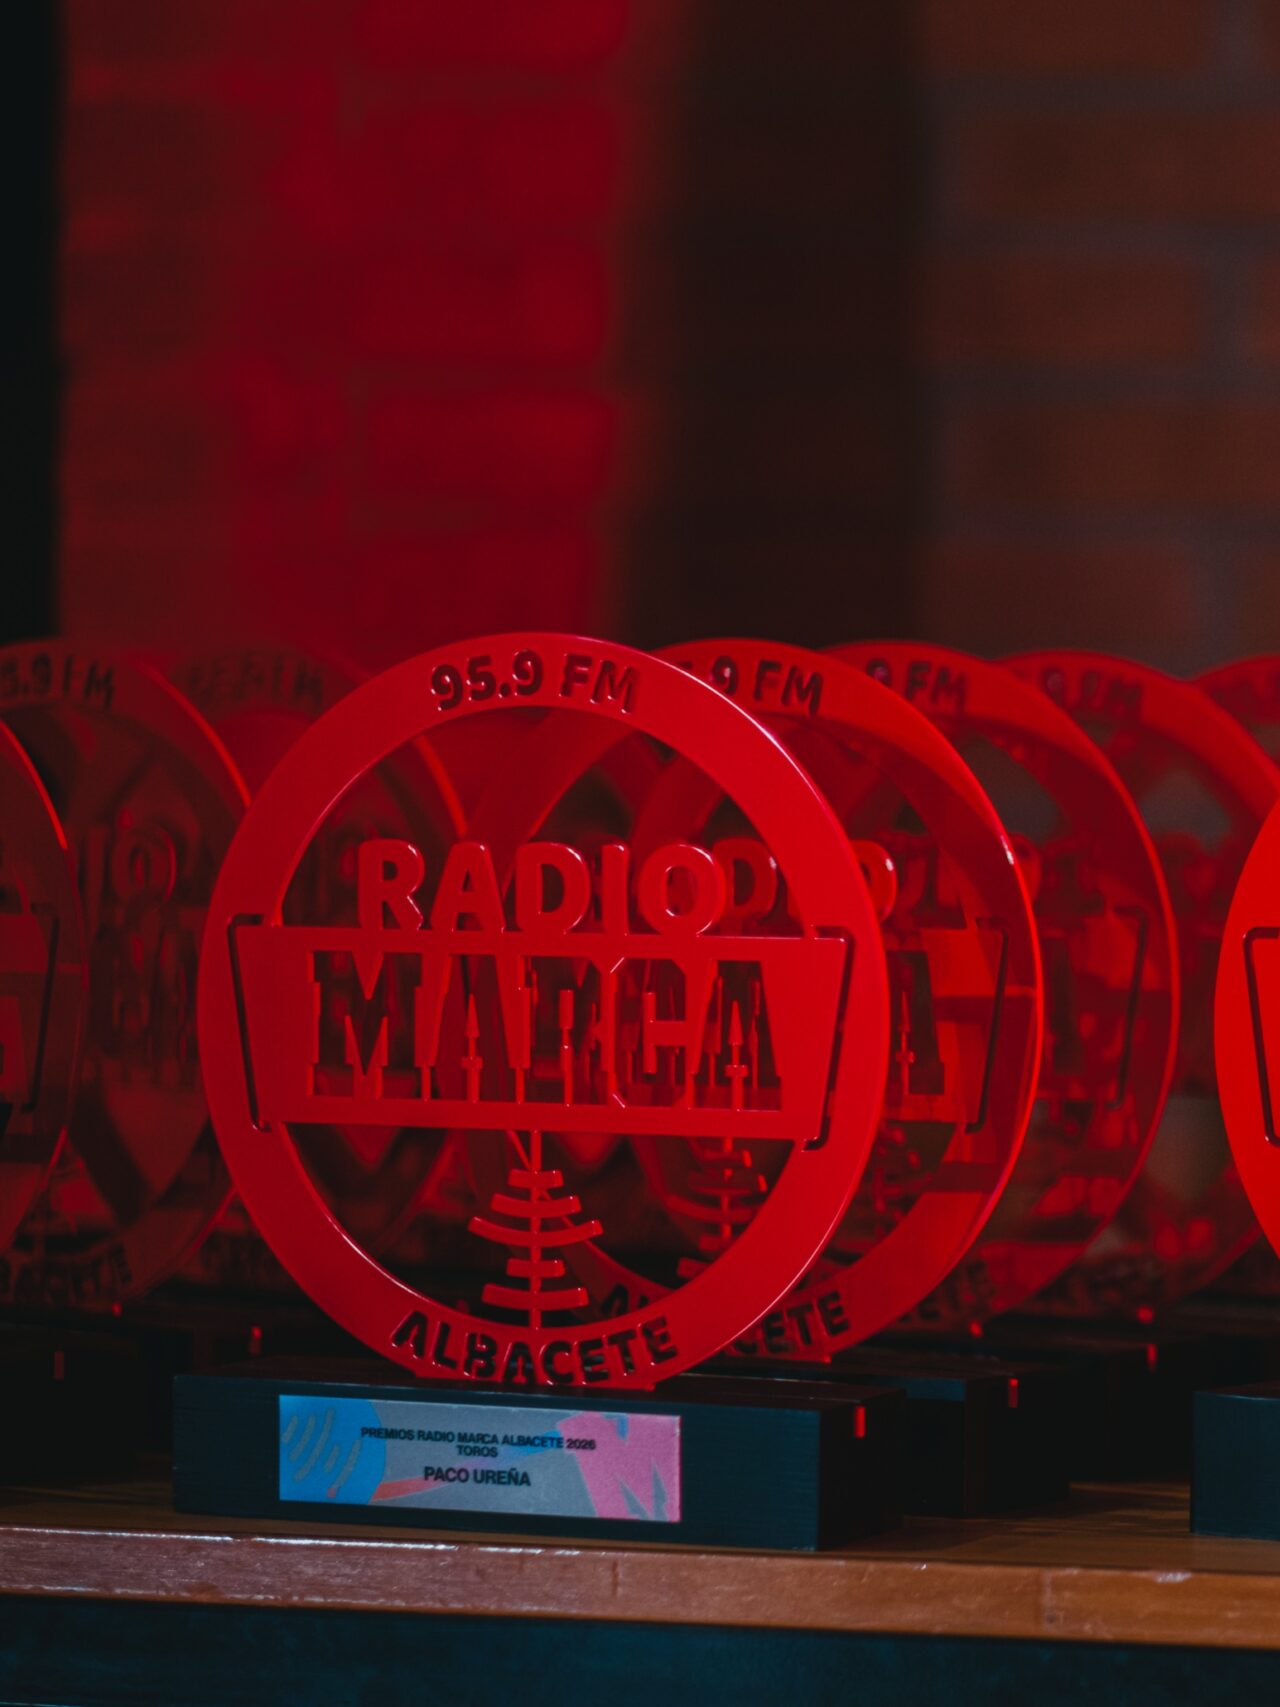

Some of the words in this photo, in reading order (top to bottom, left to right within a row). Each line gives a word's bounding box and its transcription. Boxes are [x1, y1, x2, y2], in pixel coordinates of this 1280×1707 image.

[430, 650, 543, 711] 95.9
[559, 654, 638, 714] FM
[753, 661, 824, 719] FM
[356, 838, 726, 936] RADIO
[307, 949, 782, 1113] MARCA
[389, 1307, 678, 1385] ALBACETE
[360, 1427, 416, 1441] PREMIOS
[417, 1430, 455, 1443] RADIO
[457, 1432, 499, 1445] MARCA
[501, 1434, 564, 1449] ALBACETE
[456, 1444, 498, 1458] TOROS
[423, 1466, 470, 1483] PACO
[473, 1467, 531, 1486] UREÑA
